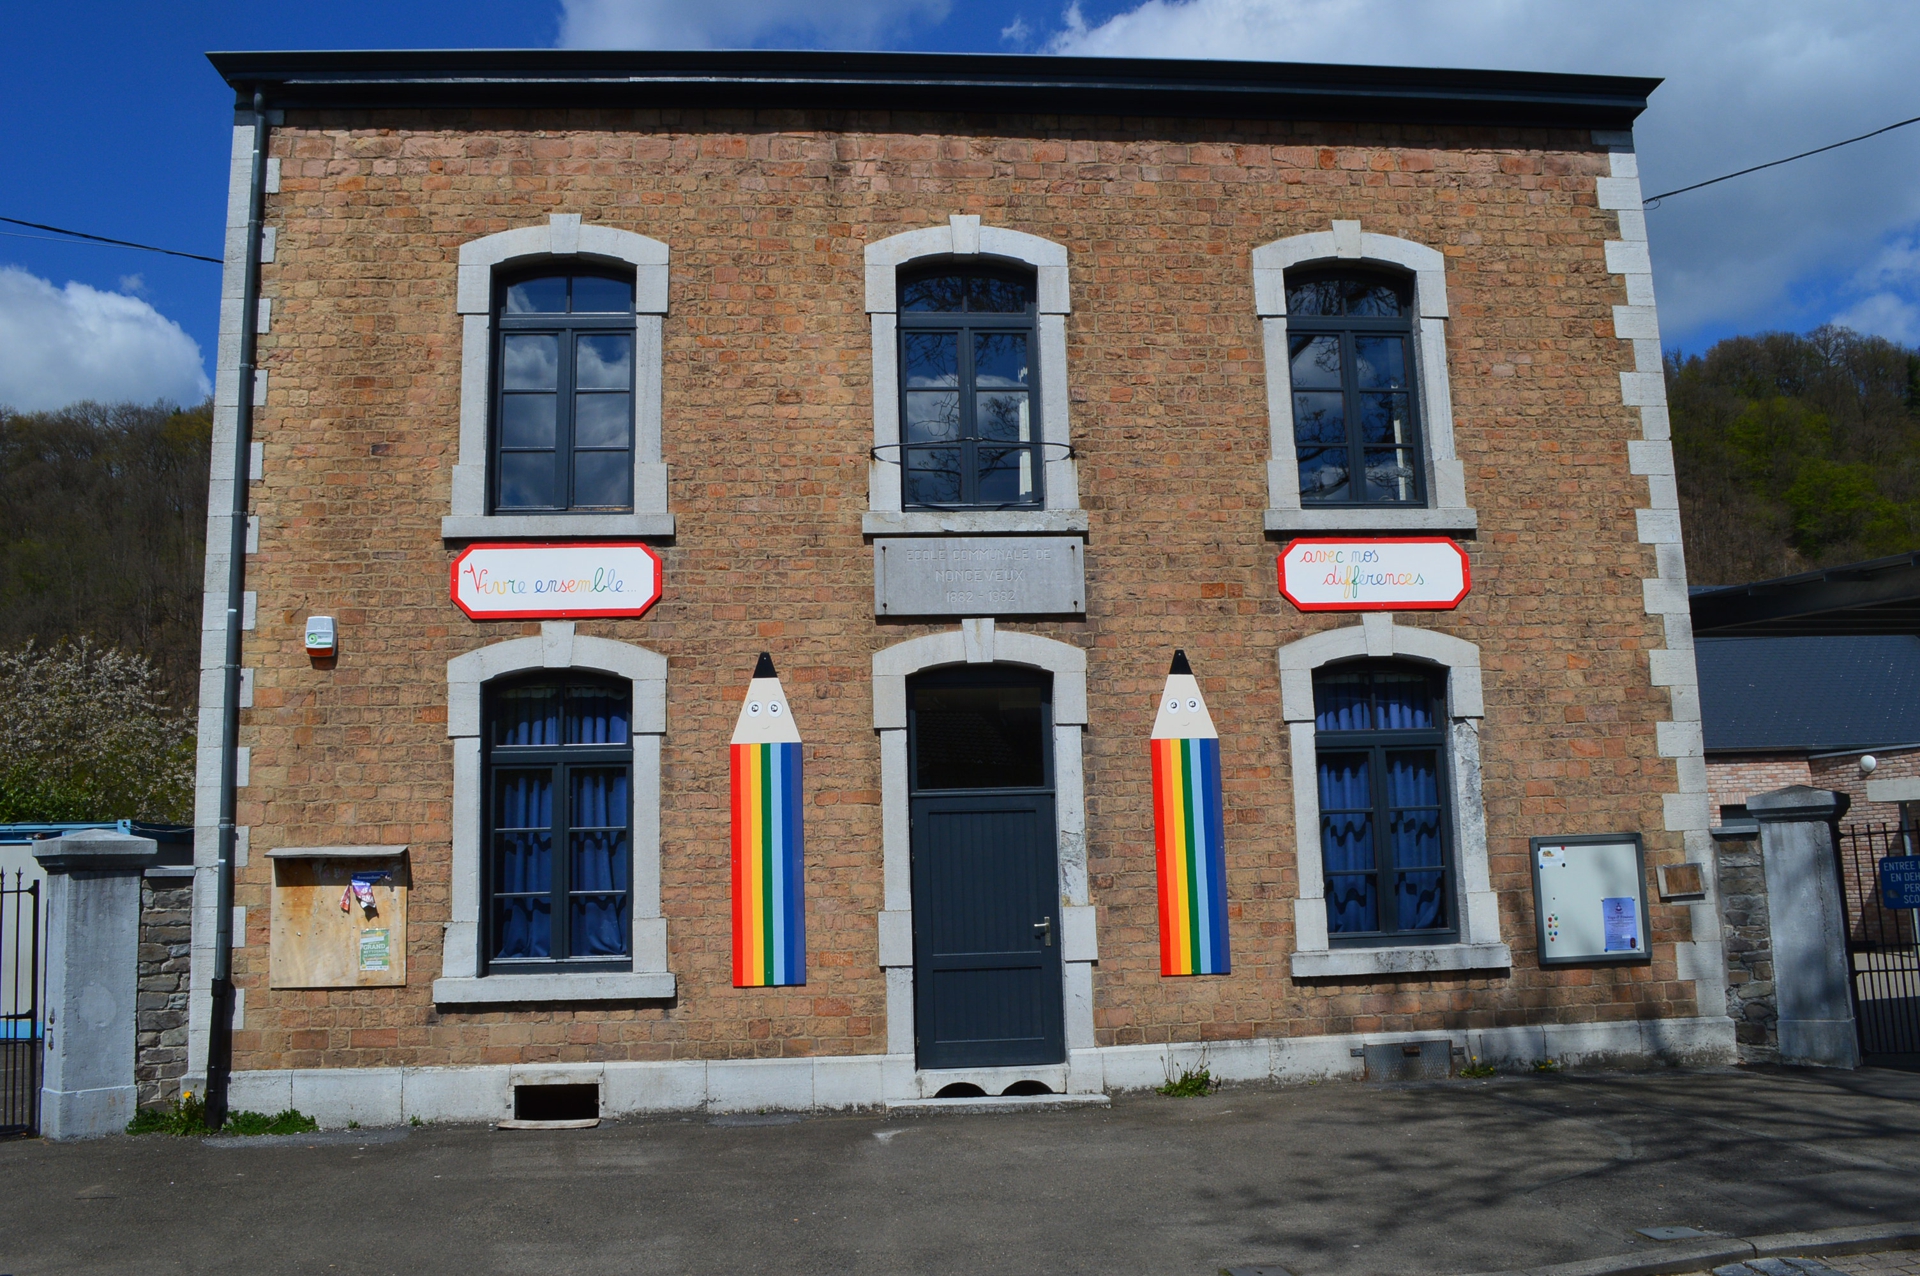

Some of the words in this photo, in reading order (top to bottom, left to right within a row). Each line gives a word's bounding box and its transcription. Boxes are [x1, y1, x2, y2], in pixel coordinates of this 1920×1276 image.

[907, 549, 945, 562] ECOLE
[953, 548, 1029, 561] COMMUNALE
[1037, 548, 1051, 560] DE
[1300, 550, 1344, 563] avec
[1351, 549, 1379, 563] nos
[463, 563, 527, 594] Vivre
[935, 569, 1024, 583] NONCEVEUX
[988, 590, 1016, 602] 1982
[1883, 861, 1915, 871] ENTREE
[1890, 873, 1901, 882] EN
